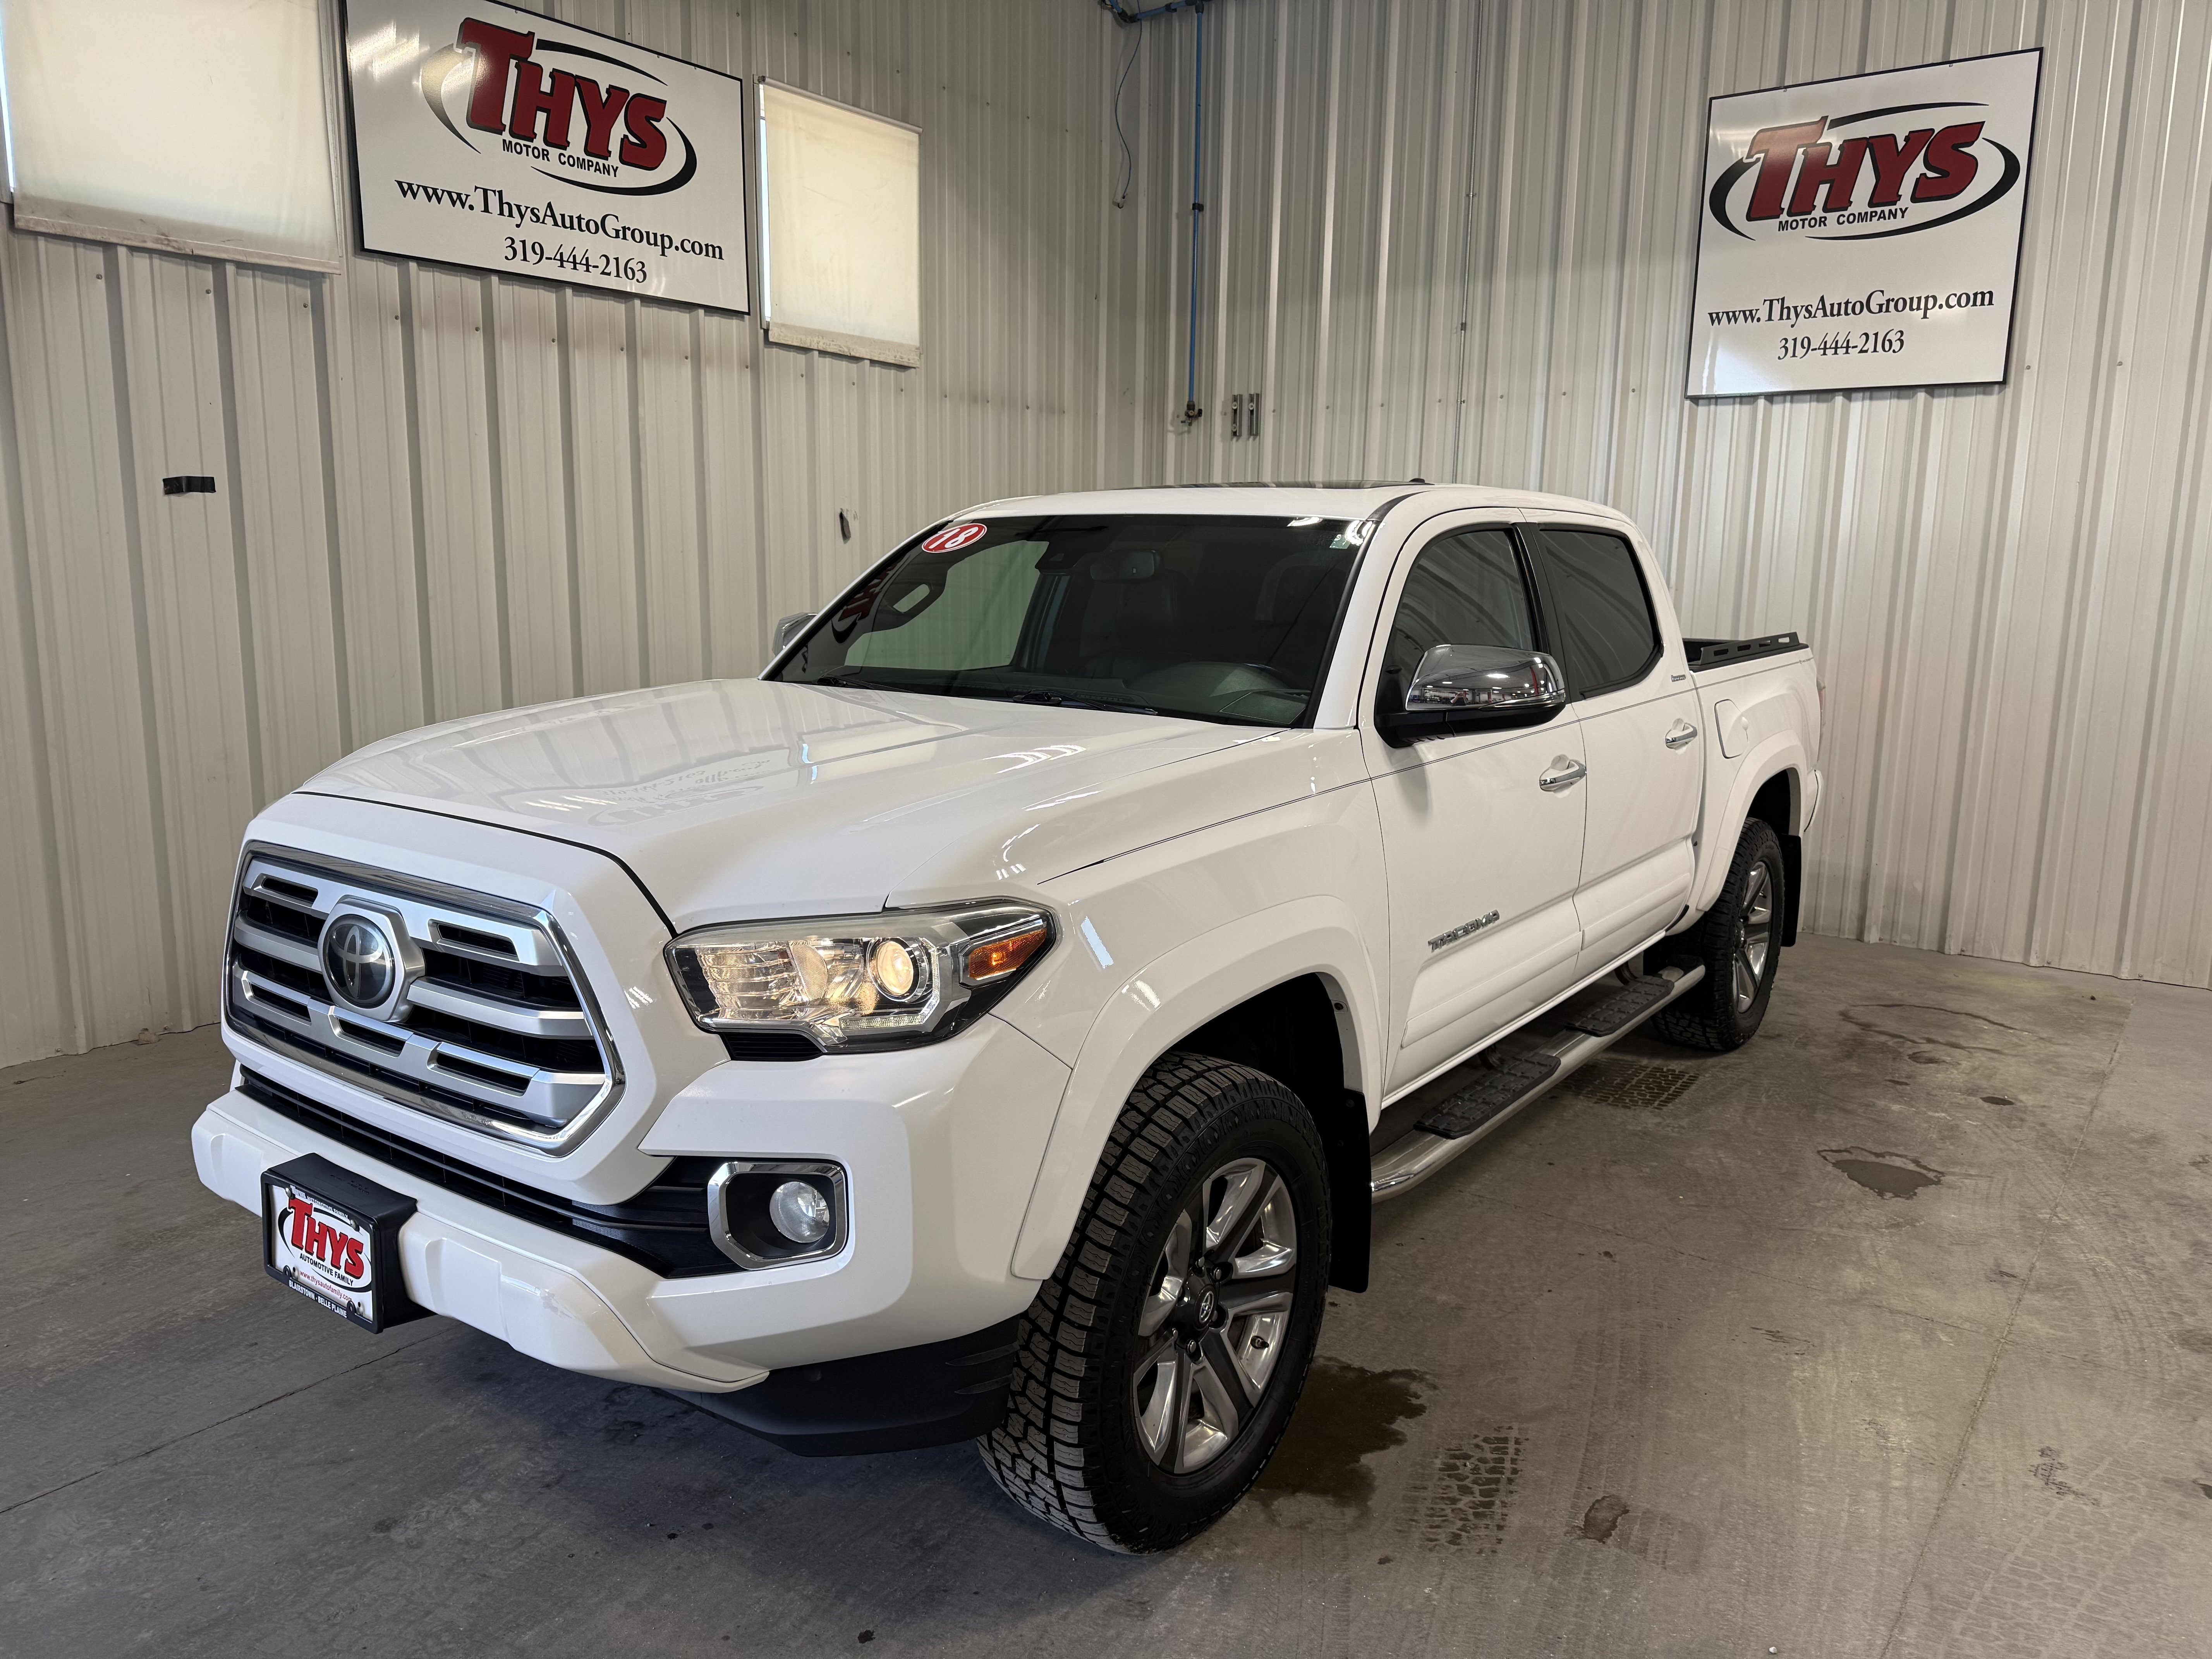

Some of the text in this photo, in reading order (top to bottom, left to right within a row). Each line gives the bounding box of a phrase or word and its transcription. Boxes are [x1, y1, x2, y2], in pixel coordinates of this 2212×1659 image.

[455, 17, 667, 171] THYS
[502, 139, 619, 178] MOTOR COMPANY
[1745, 115, 1985, 222] THYS
[395, 179, 725, 260] www.ThysAutoGroup.com
[1778, 207, 1908, 232] MOTOR COMPANY
[504, 237, 647, 283] 319-444-2163
[1708, 288, 1994, 328] www.ThysAutoGroup.com
[1778, 330, 1905, 360] 319-444-2163
[929, 527, 978, 549] 18
[1428, 910, 1499, 953] TACOMA
[288, 1197, 364, 1279] THYS
[300, 1253, 353, 1286] AUTOMOTIVE FAMILY
[300, 1271, 352, 1301] www.thysautofamily.com
[289, 1280, 347, 1318] BLAIRSTOWN BELLE PLAINE
